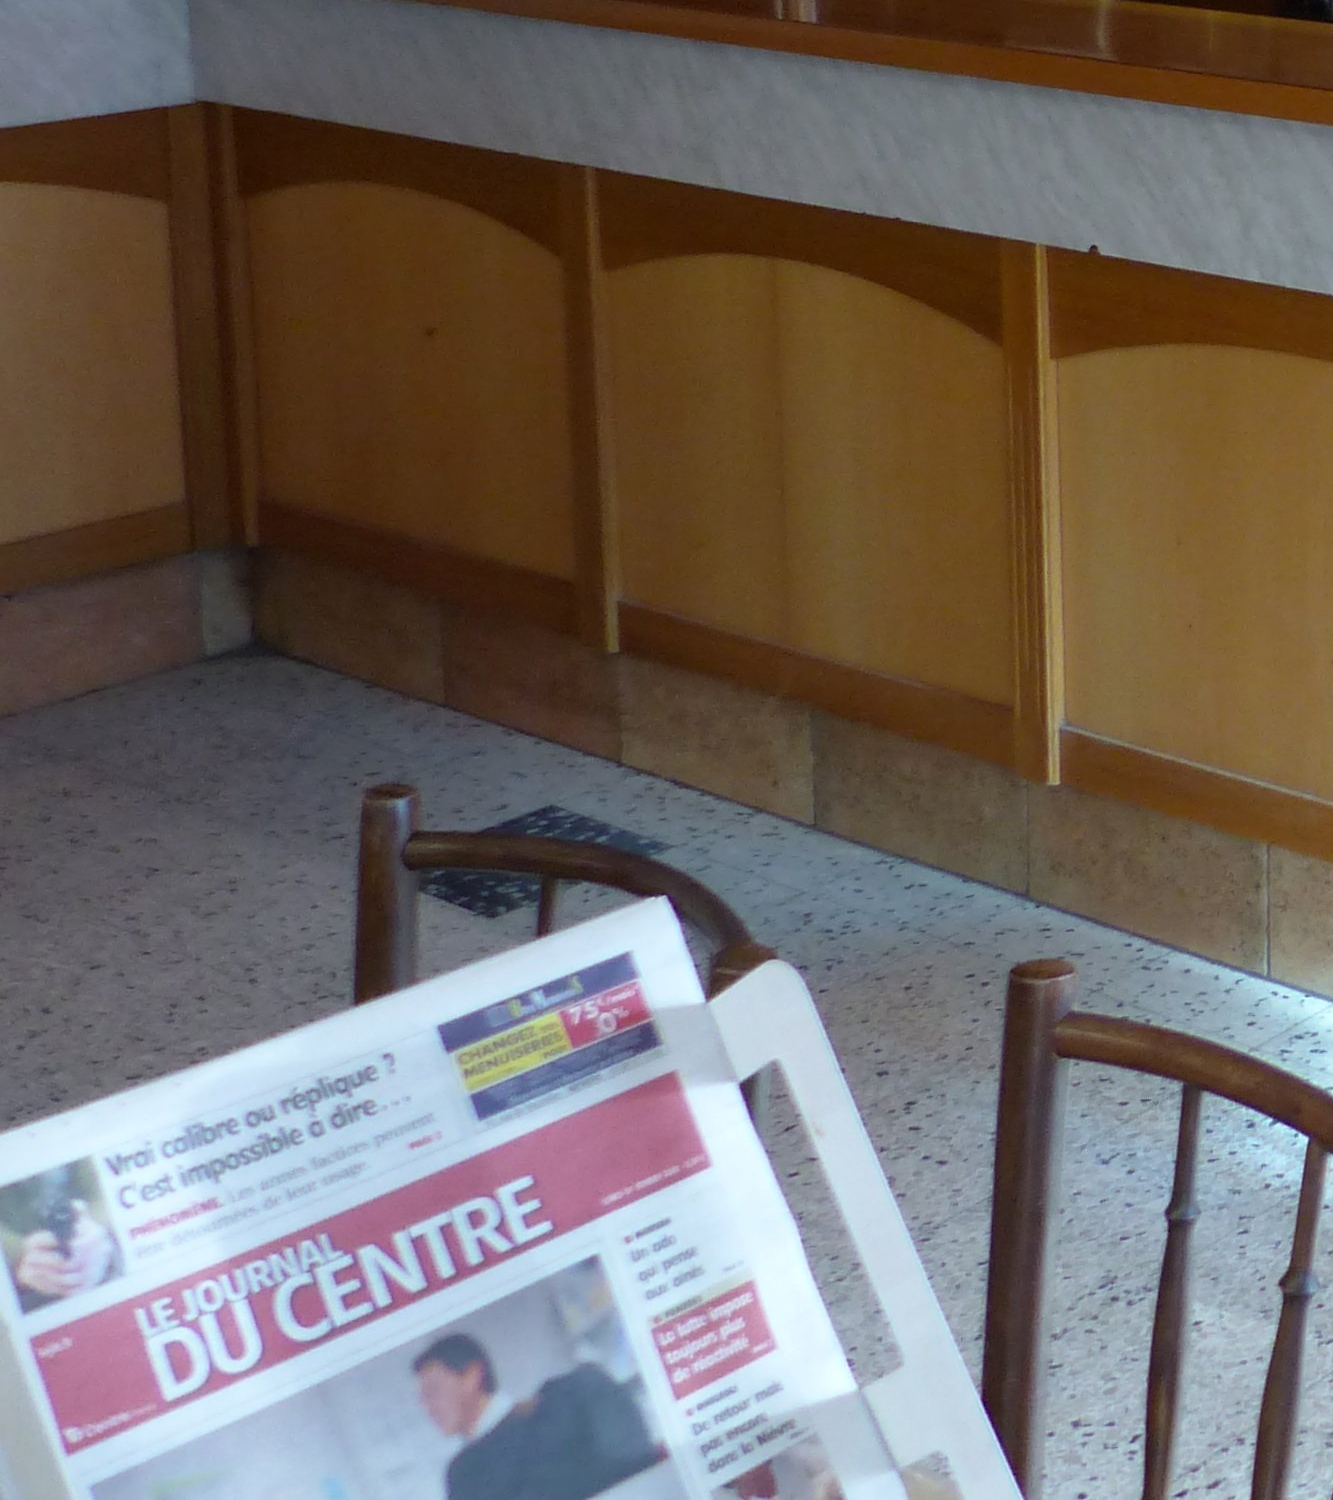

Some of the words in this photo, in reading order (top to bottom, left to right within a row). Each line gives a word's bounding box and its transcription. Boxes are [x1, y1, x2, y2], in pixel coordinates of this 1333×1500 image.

[105, 1141, 158, 1177] Vrai
[160, 1117, 242, 1160] calibre
[244, 1102, 278, 1129] ou
[279, 1062, 382, 1115] réplique
[382, 1051, 397, 1076] ?
[117, 1171, 177, 1210] C'est
[180, 1125, 305, 1187] impossible
[308, 1112, 328, 1139] à
[135, 1295, 180, 1335] LE
[181, 1232, 347, 1322] JOURNAL
[144, 1296, 266, 1403] DU
[271, 1174, 555, 1344] CENTRE
